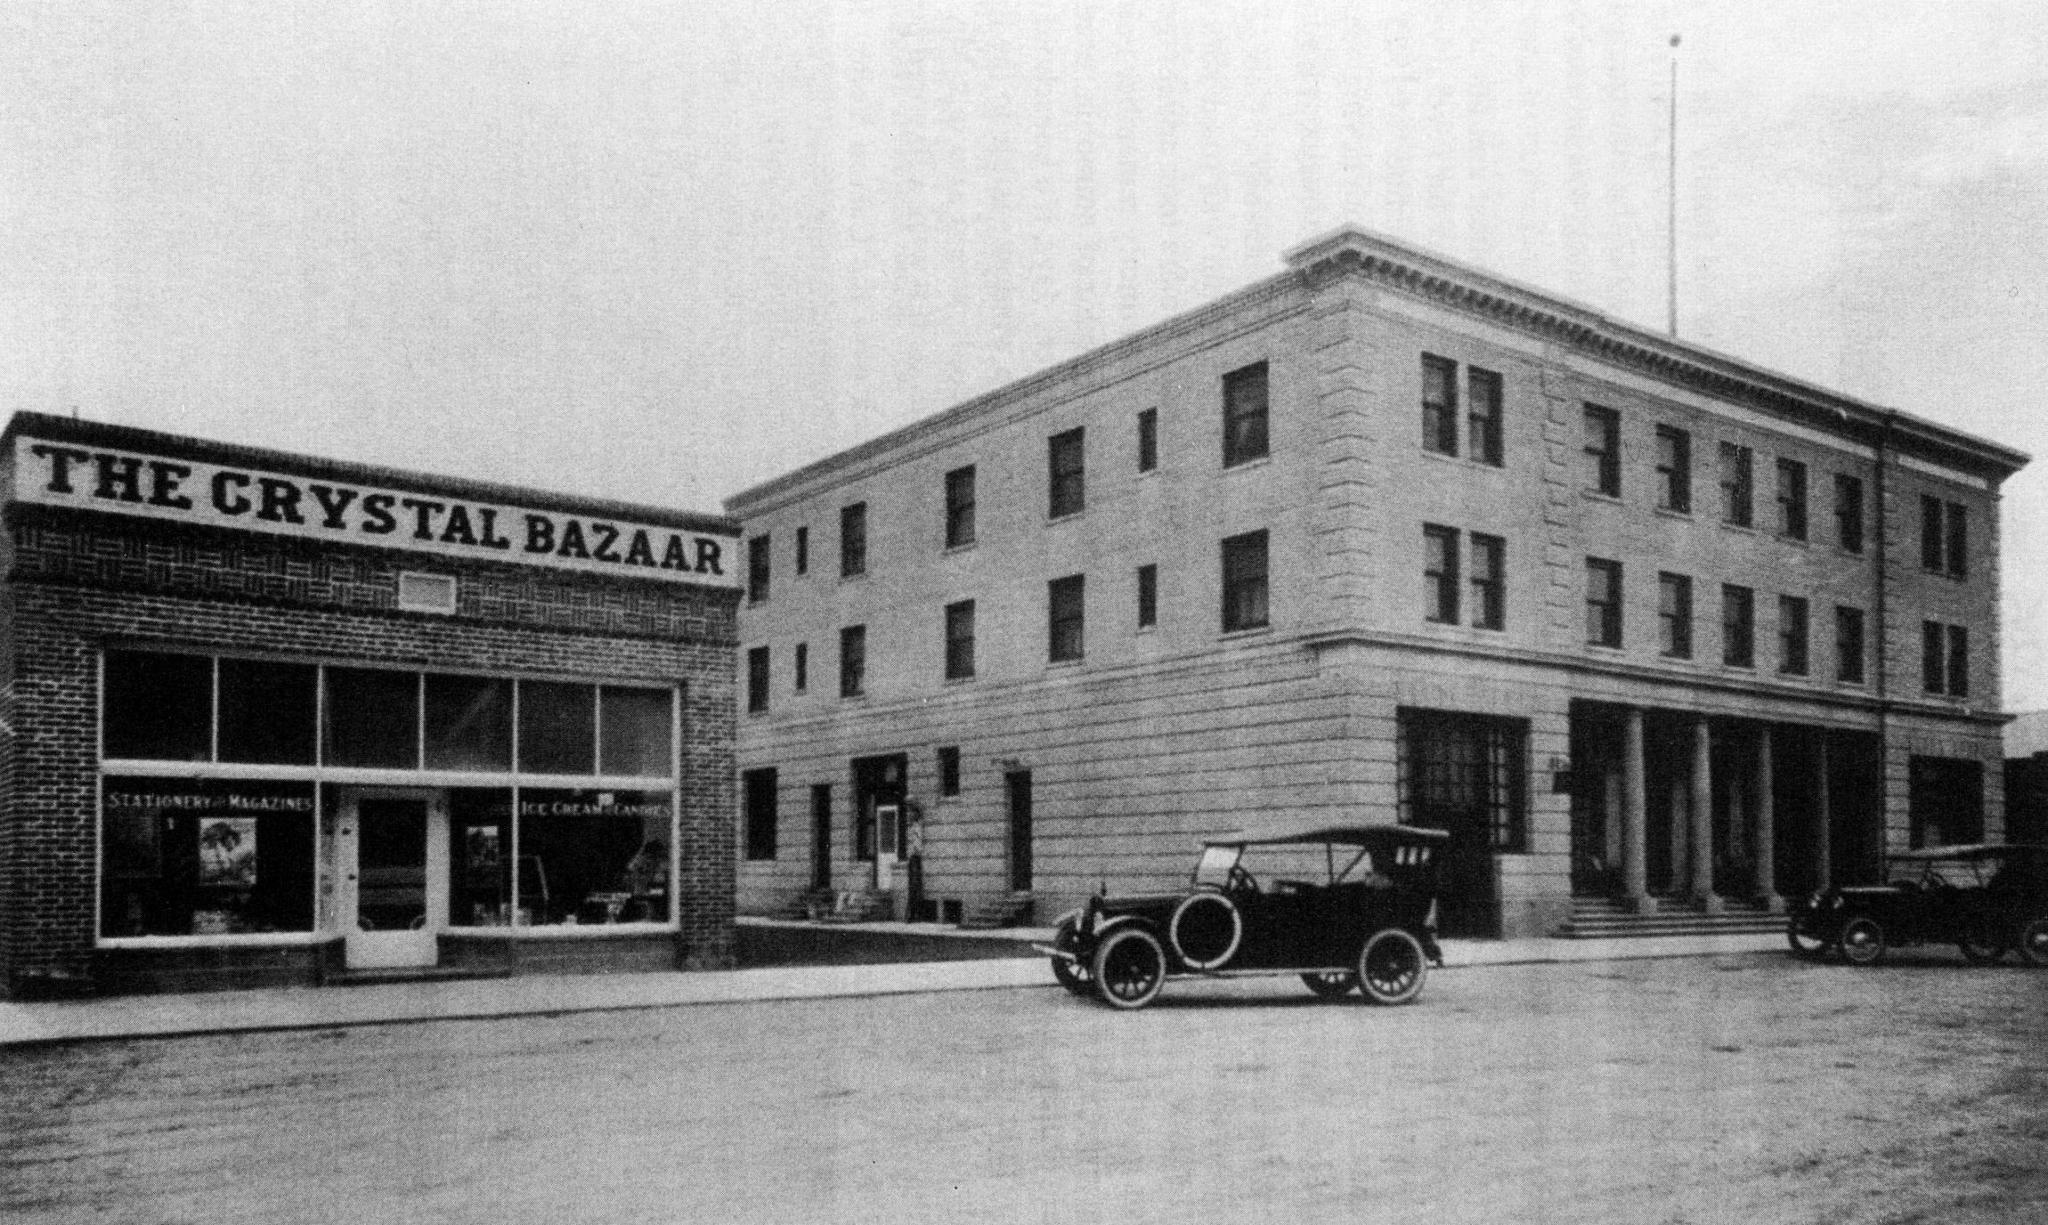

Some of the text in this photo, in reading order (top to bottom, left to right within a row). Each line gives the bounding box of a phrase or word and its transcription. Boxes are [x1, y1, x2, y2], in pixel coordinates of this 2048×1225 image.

[30, 443, 725, 576] THE CRYSTAL BAZAAR
